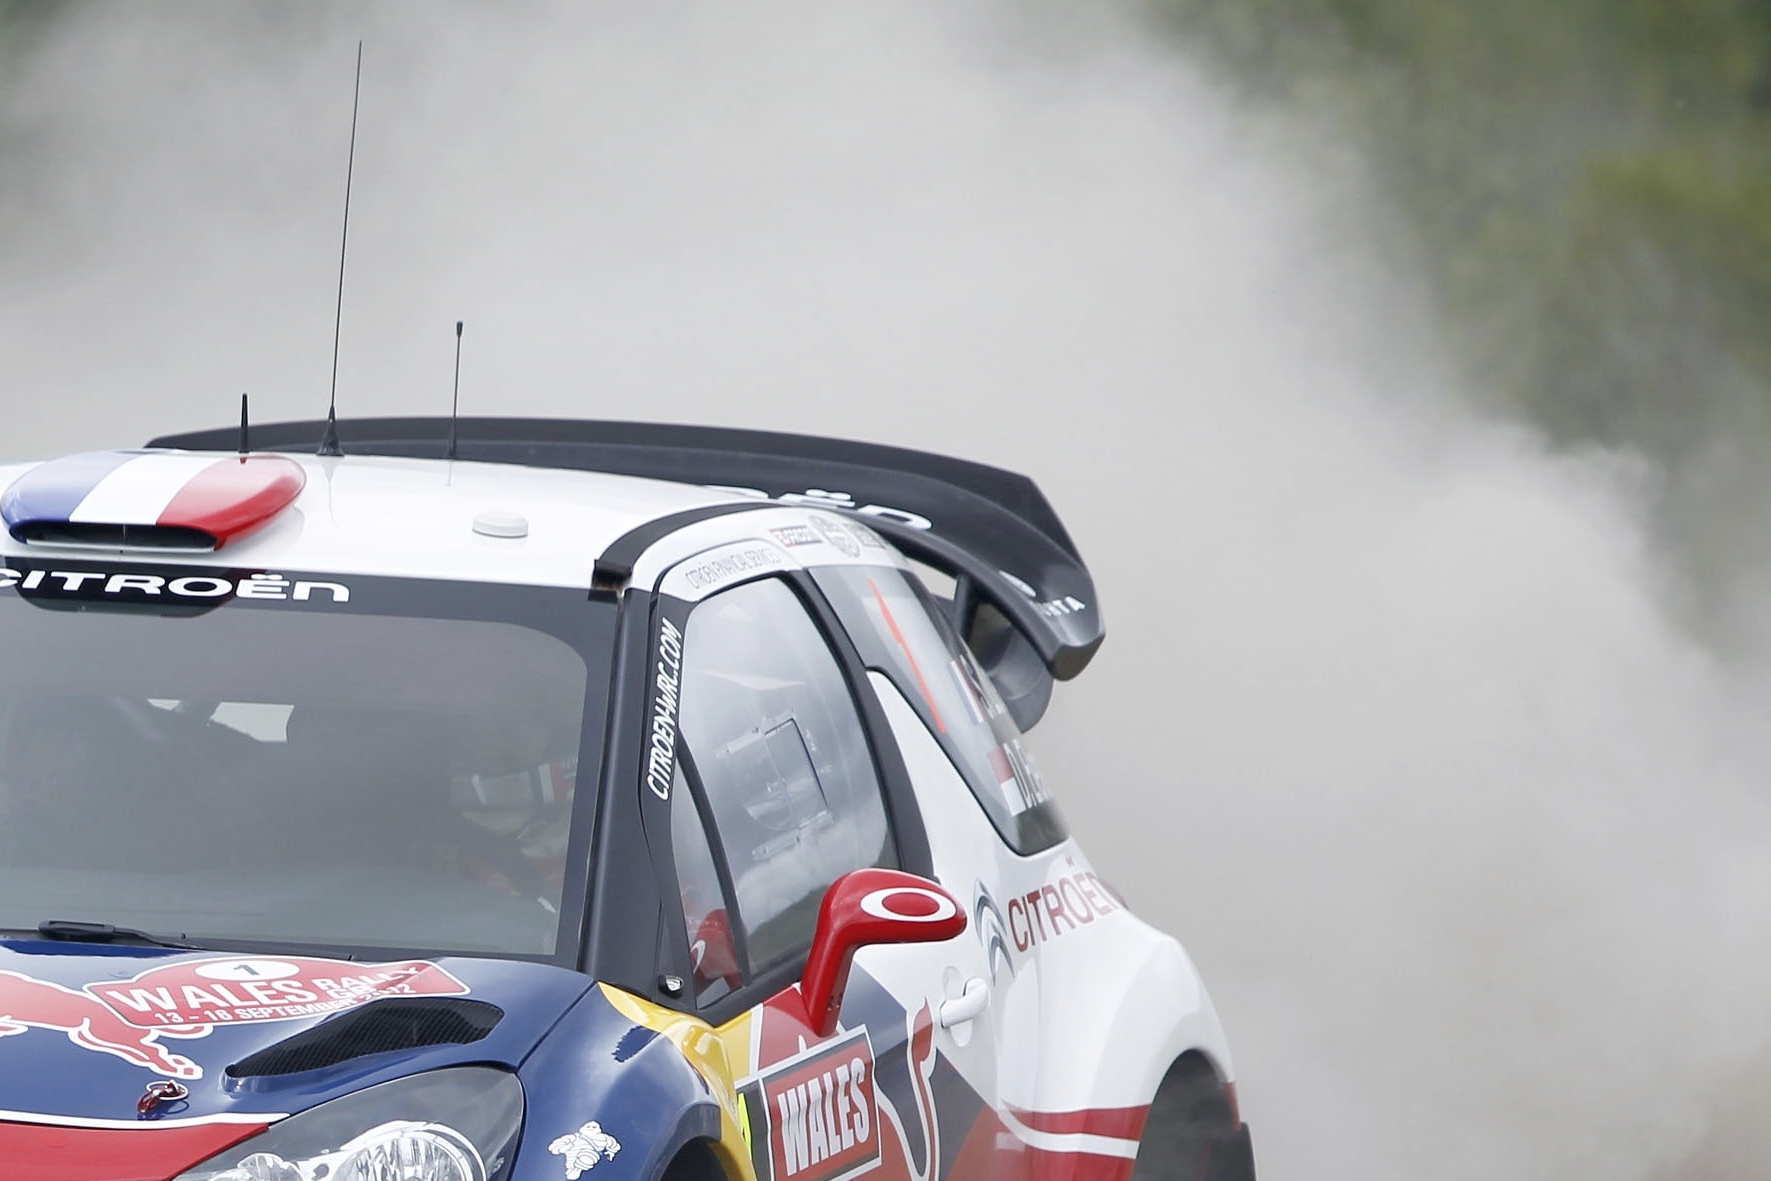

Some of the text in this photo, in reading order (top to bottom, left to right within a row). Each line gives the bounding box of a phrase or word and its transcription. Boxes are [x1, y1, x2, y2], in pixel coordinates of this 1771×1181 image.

[647, 616, 682, 801] CITROEN-WRC.COM
[106, 966, 420, 1013] WALES RALLY
[233, 963, 260, 976] 1
[154, 1012, 184, 1025] 13
[238, 997, 356, 1020] SEPTEMBER
[776, 1057, 871, 1178] WALES
